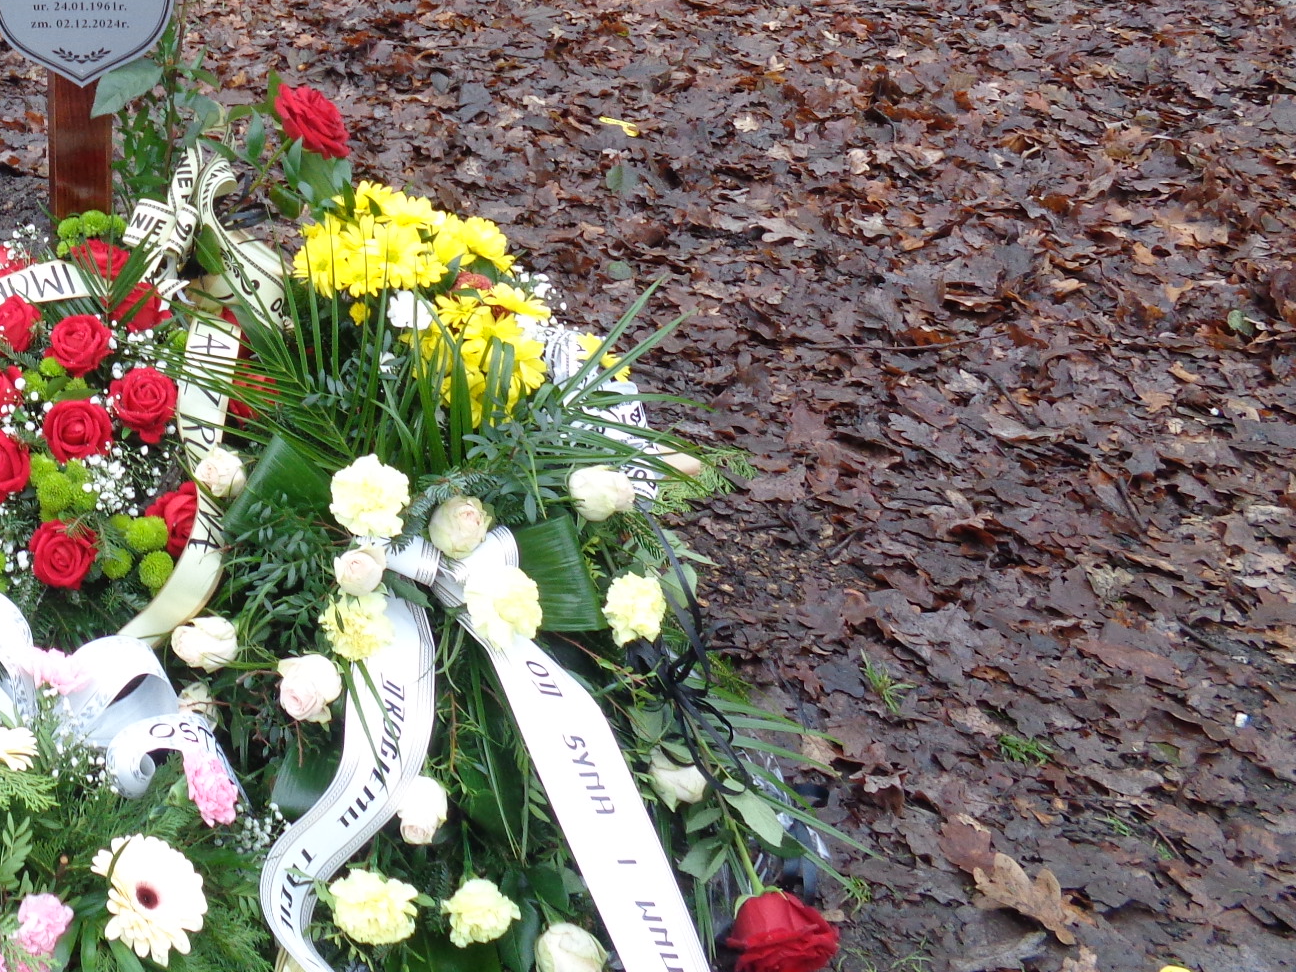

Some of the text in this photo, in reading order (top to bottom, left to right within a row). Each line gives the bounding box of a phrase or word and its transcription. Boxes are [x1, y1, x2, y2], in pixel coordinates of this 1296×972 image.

[33, 1, 128, 12] ur. 24.01.1961r.
[30, 19, 131, 30] zm. 02.12.2024r.
